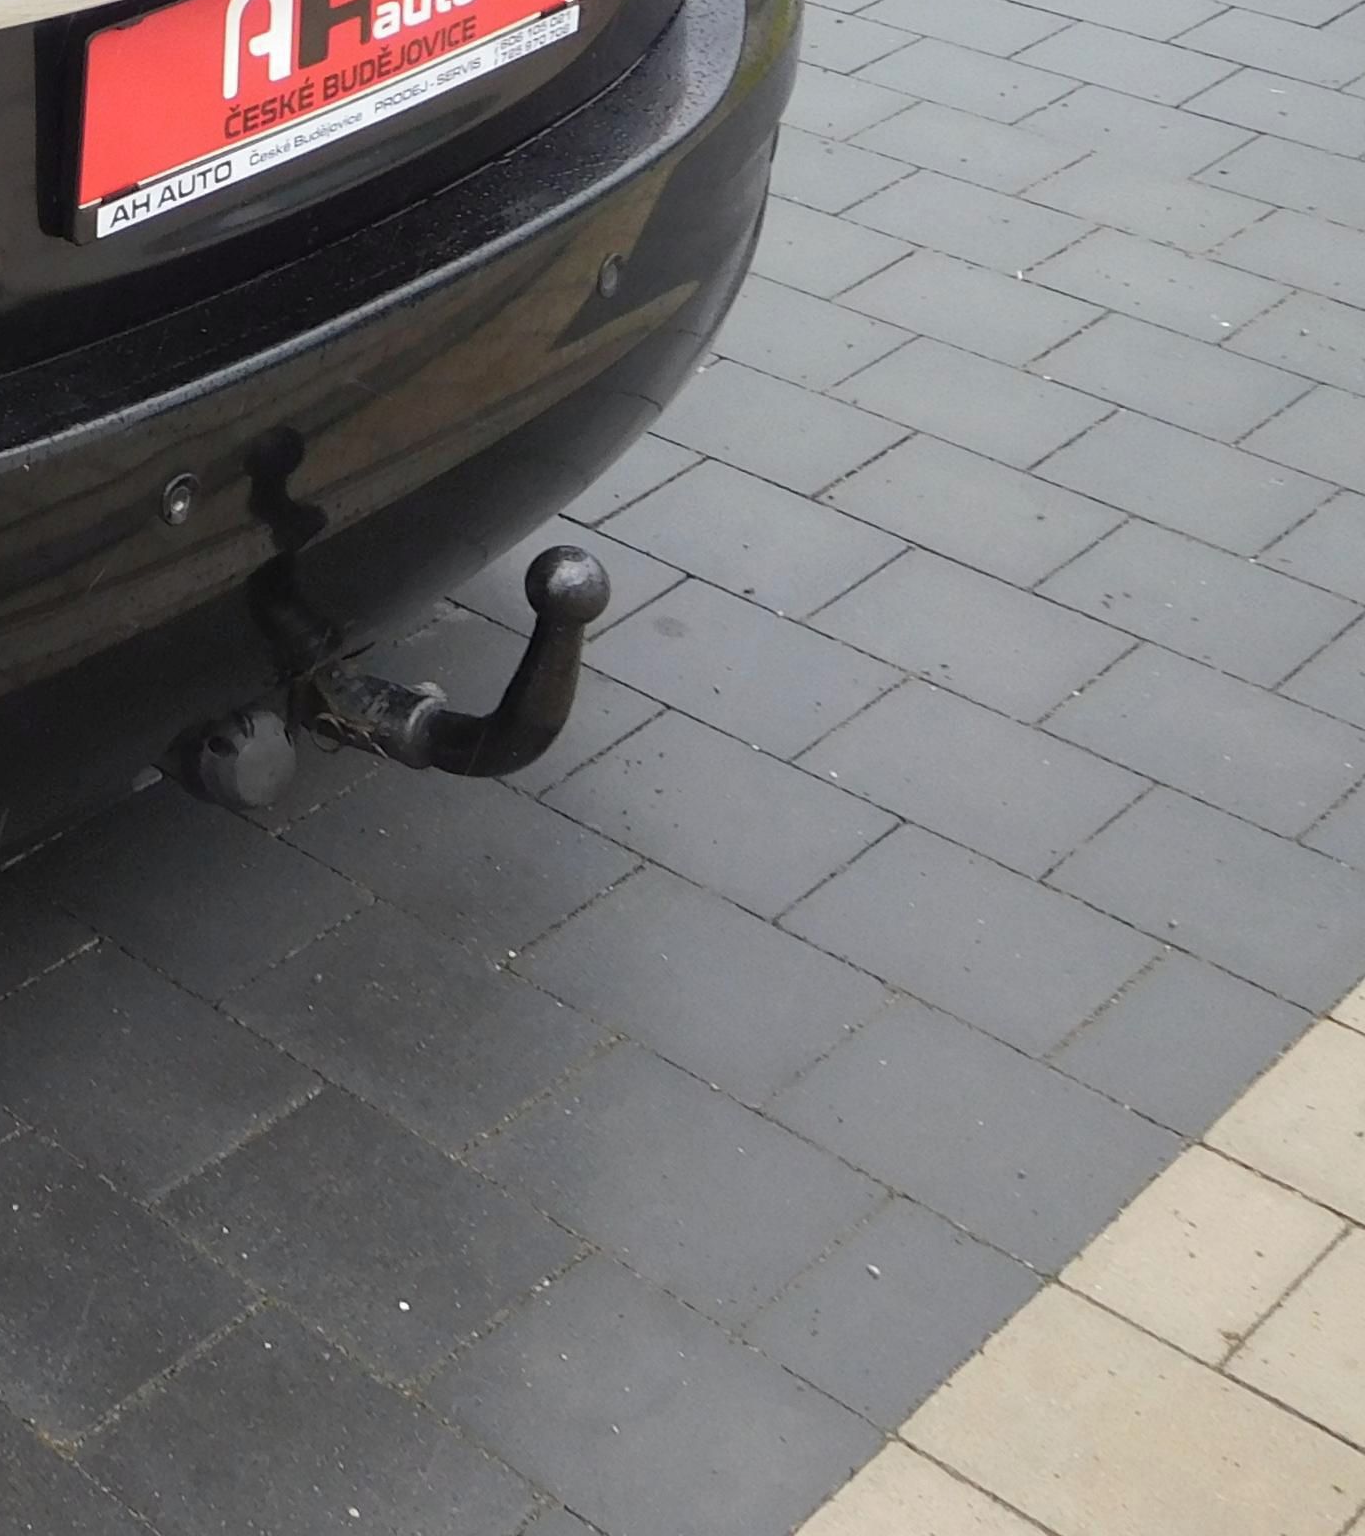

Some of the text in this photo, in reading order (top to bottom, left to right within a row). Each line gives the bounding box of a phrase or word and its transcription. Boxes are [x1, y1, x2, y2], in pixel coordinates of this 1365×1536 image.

[224, 15, 477, 140] ČESKÉ BUDĚJOVICE
[109, 194, 151, 228] AH
[156, 160, 233, 209] AUTO
[249, 136, 291, 167] České
[293, 110, 364, 149] Budějovice
